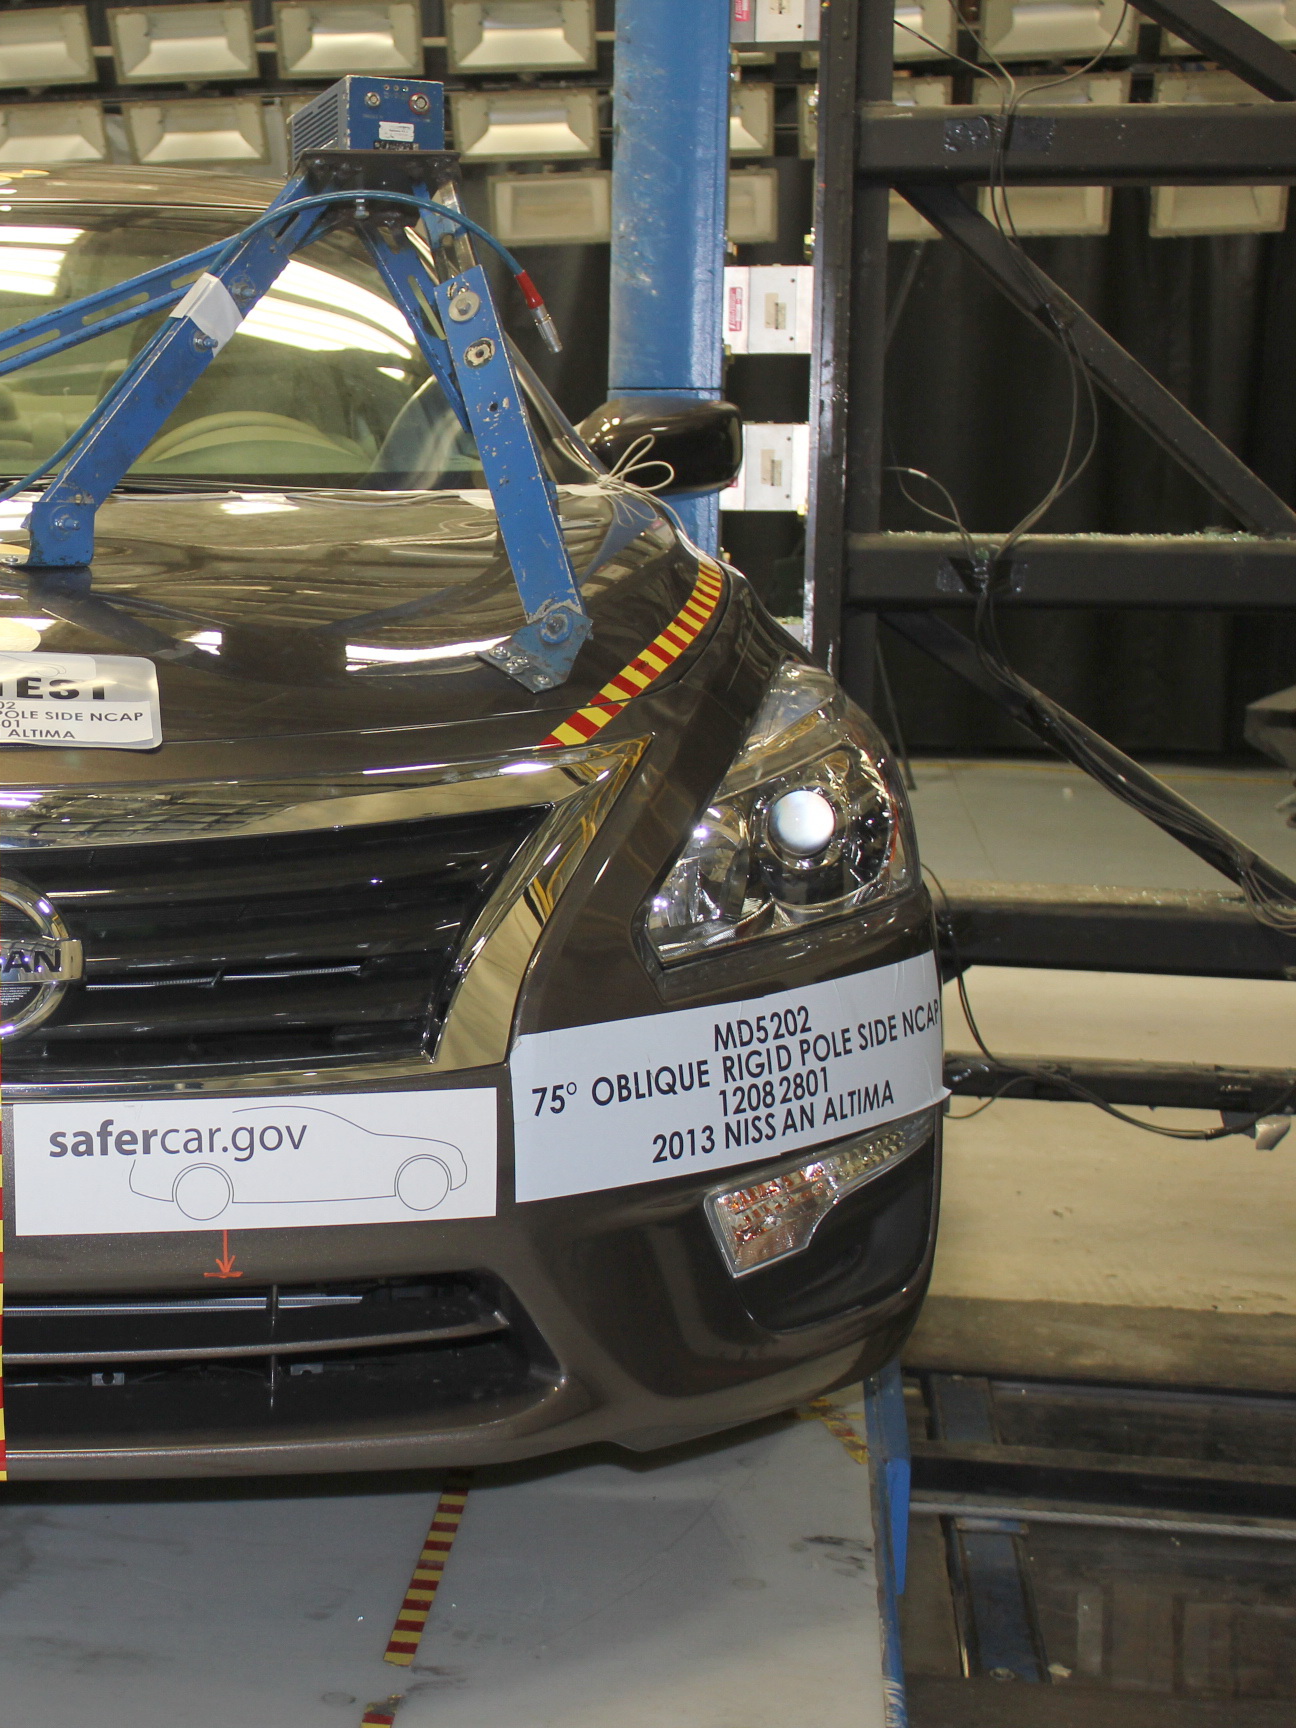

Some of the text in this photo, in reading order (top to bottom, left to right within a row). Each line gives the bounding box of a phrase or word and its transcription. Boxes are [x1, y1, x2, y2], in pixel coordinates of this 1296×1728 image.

[8, 728, 76, 739] ALTIMA
[45, 711, 84, 721] SIDE
[90, 712, 143, 721] NCAP
[713, 1005, 812, 1052] MD5202
[591, 1059, 710, 1107] OBLIQUE
[721, 1044, 792, 1084] RIGID
[799, 1027, 853, 1066] POLE
[857, 1014, 898, 1051] SIDE
[901, 998, 939, 1038] NCAP
[718, 1066, 829, 1117] 12082801
[48, 1118, 308, 1163] safercar.gov
[652, 1079, 895, 1164] 2013 NISSAN ALTIMA
